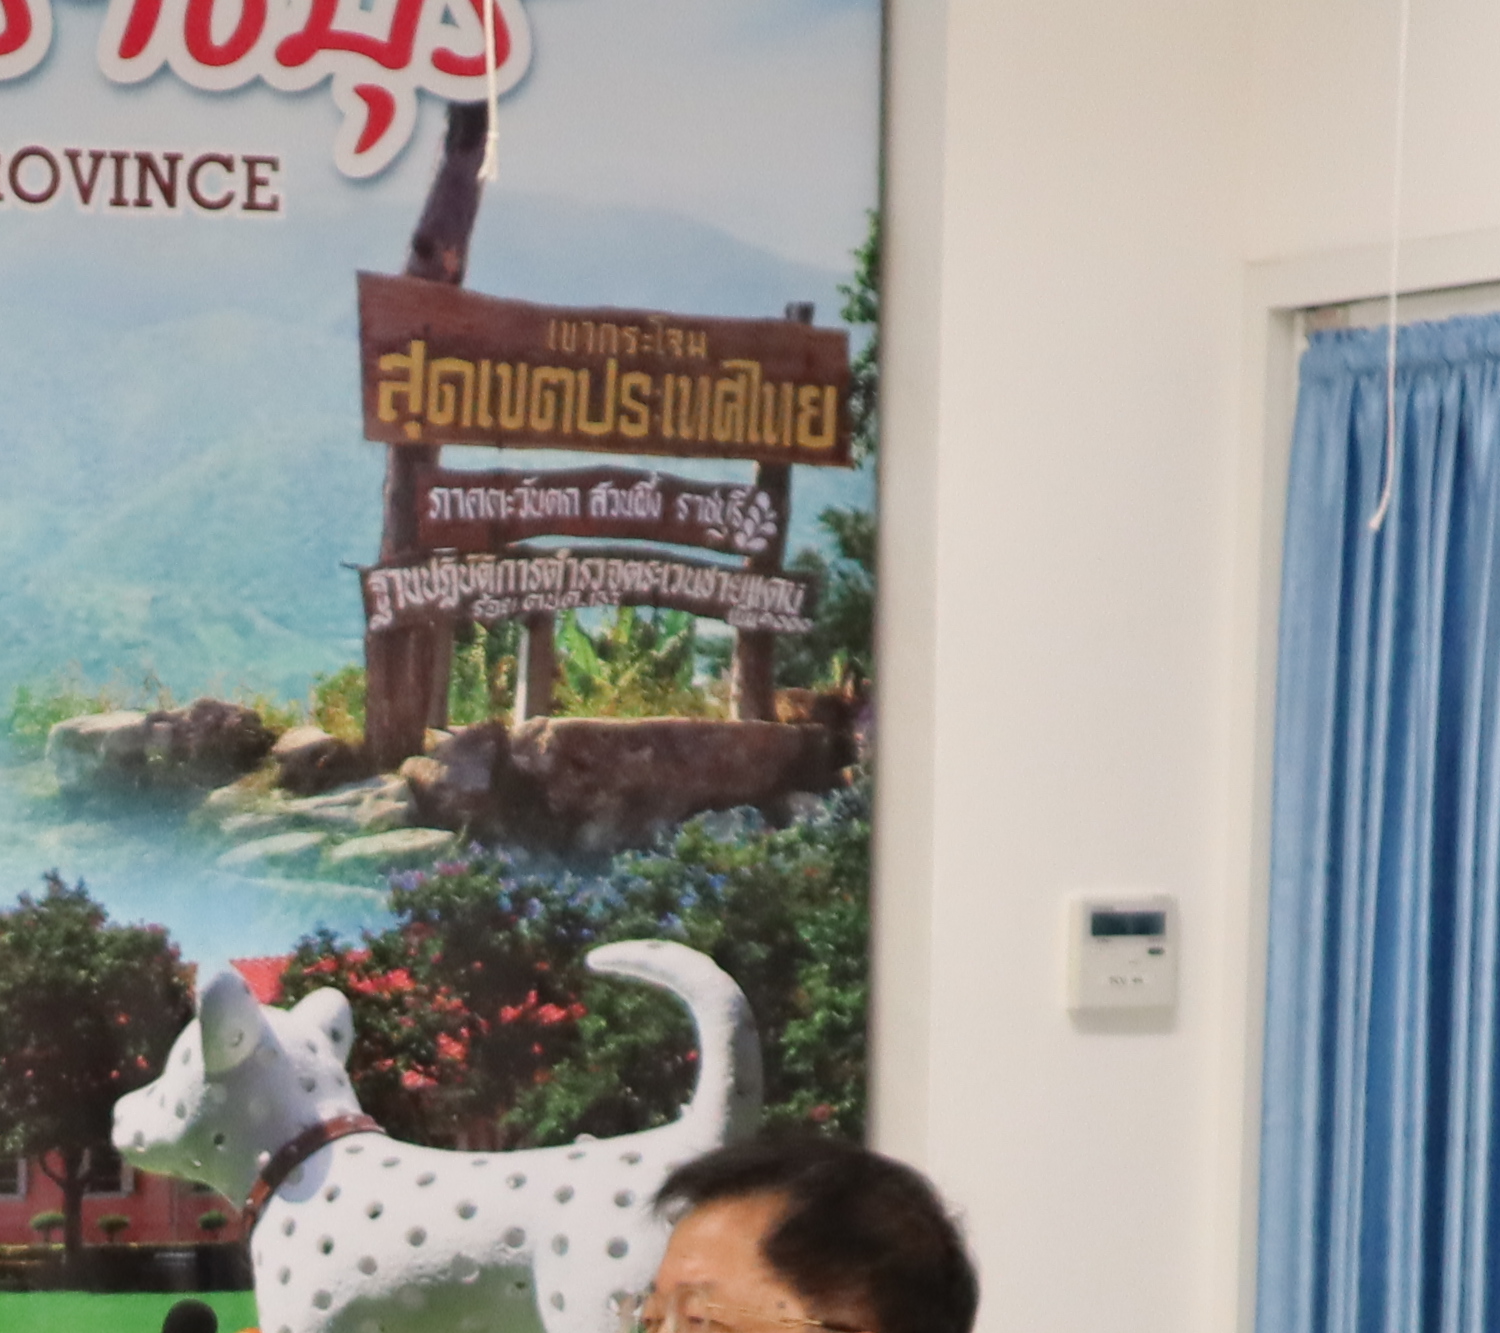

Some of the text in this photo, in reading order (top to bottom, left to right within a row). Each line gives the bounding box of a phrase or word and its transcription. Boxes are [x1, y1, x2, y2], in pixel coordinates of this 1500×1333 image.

[547, 315, 708, 358] เขากระโจม
[376, 339, 837, 448] สุดเขตประเทศไทย
